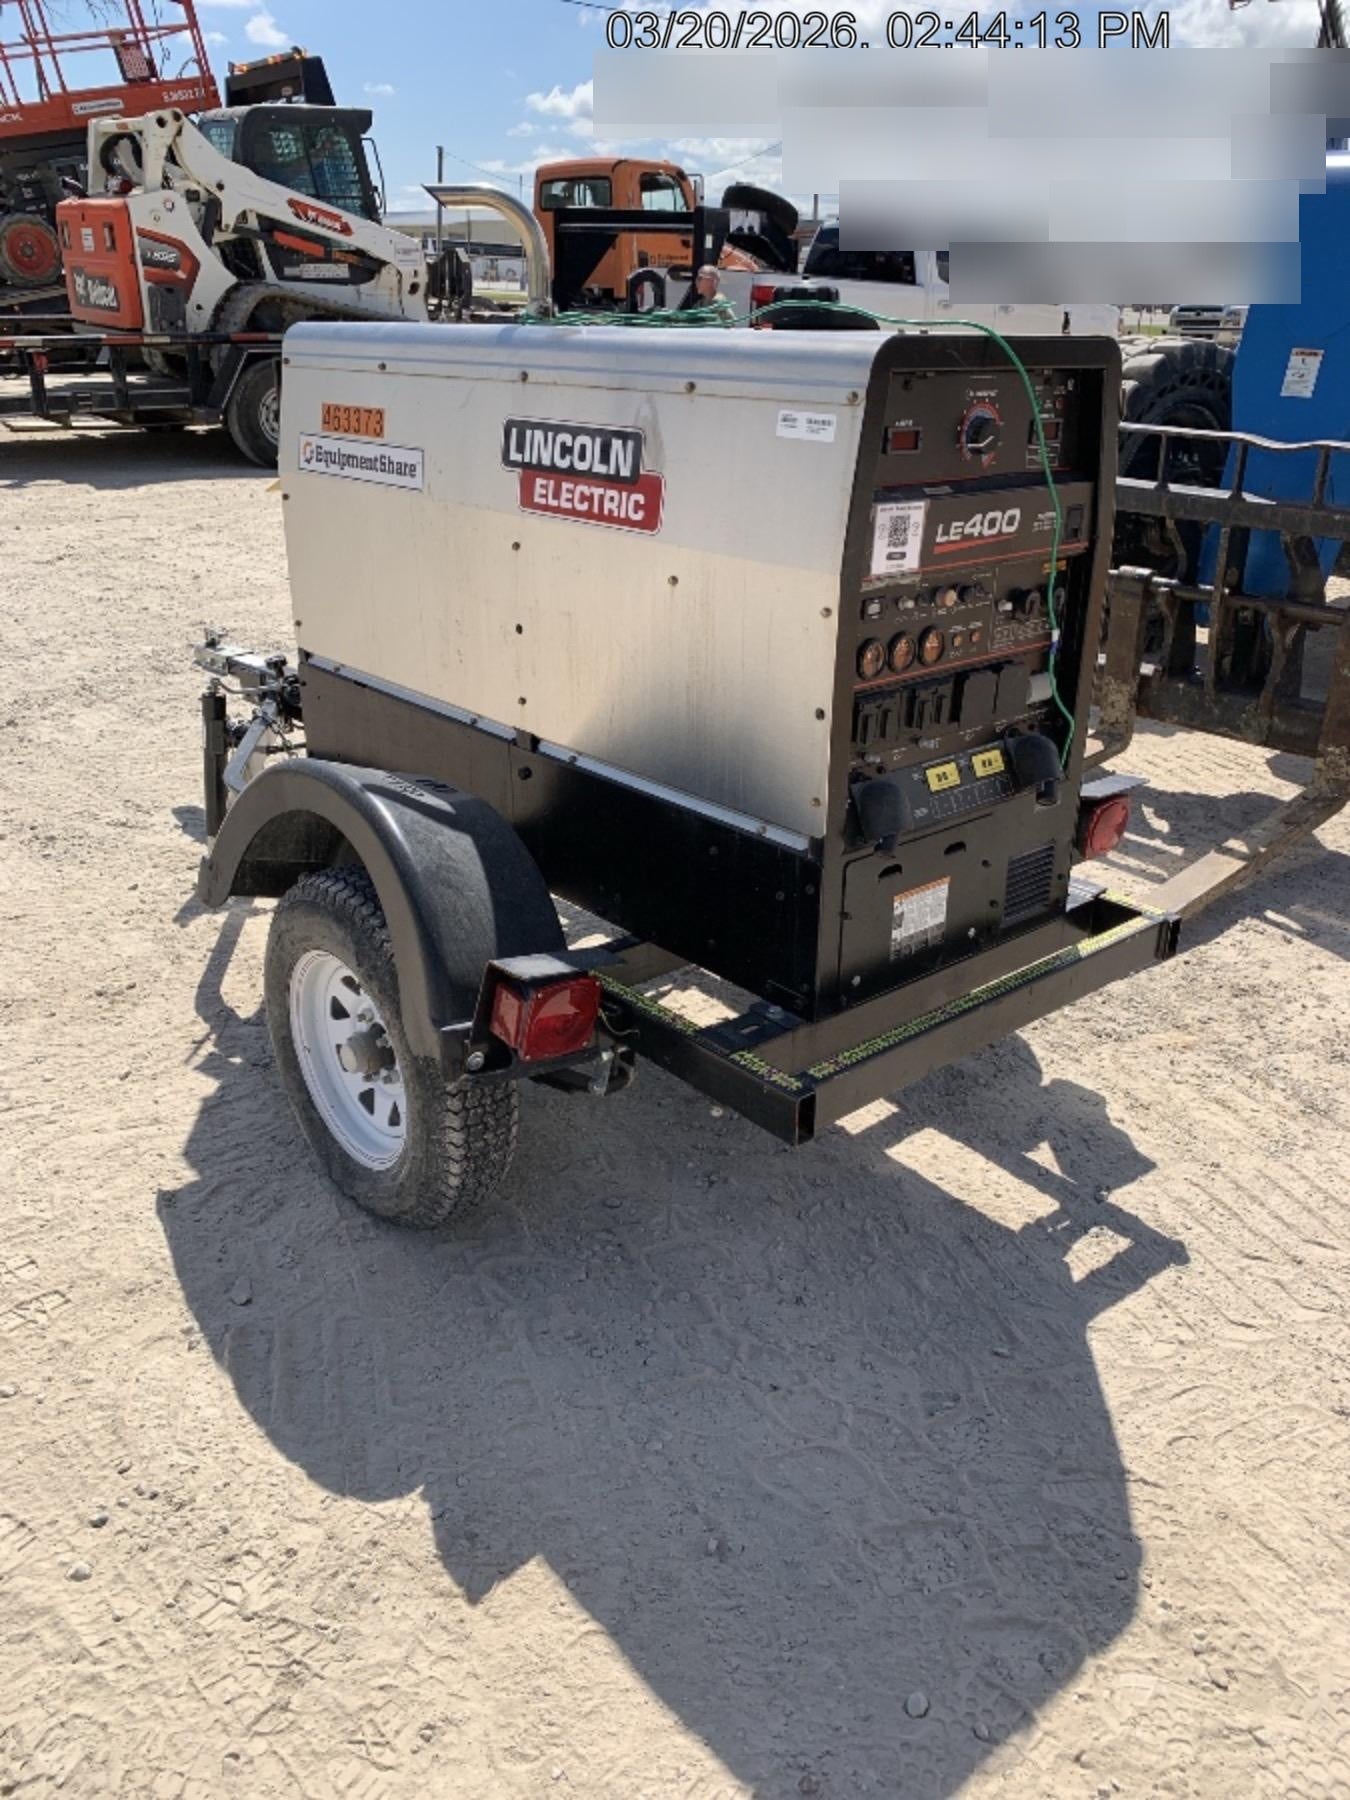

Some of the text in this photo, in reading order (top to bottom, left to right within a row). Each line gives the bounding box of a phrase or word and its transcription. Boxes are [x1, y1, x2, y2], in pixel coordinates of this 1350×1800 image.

[315, 444, 417, 479] EquipmentShare
[509, 427, 635, 478] LINCOLN
[533, 477, 646, 521] ELECTRIC
[935, 507, 1021, 543] LE400
